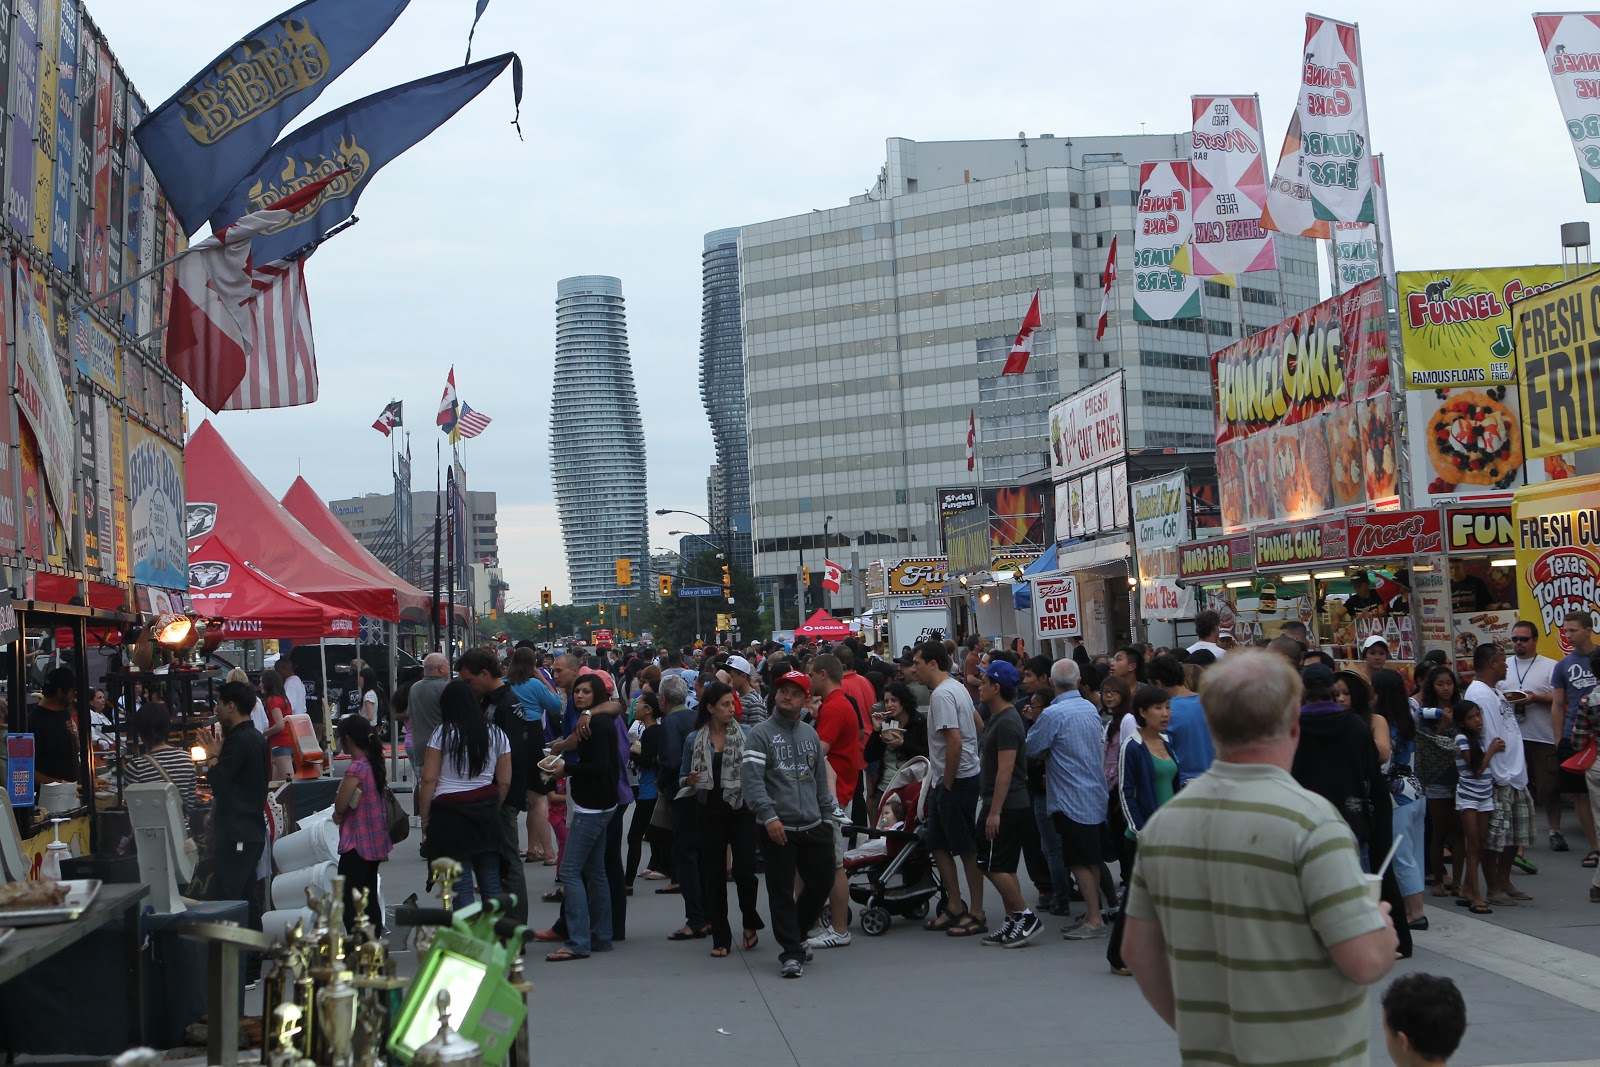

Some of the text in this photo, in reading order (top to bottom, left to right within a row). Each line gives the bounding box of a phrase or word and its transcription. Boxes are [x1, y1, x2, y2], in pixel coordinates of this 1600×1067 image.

[1408, 292, 1504, 328] FUNNEL
[1520, 292, 1586, 359] FRESH
[1282, 326, 1344, 402] CAKE
[1490, 363, 1508, 372] DEEP
[1491, 371, 1510, 380] FRIED
[1412, 368, 1485, 384] FAMOUS FLOATS
[1085, 391, 1108, 418] FRESH
[1077, 425, 1093, 461] CUT
[1096, 413, 1121, 453] FRIES
[162, 449, 183, 538] BBQ
[942, 500, 975, 510] Fingers
[945, 492, 973, 503] Sticky
[1140, 523, 1154, 542] Corn
[1163, 518, 1176, 538] Cob
[1350, 517, 1367, 527] FRIED
[1520, 513, 1573, 549] FRESH
[1257, 531, 1294, 564] FUNNEL
[1294, 528, 1321, 560] CAKE
[1354, 515, 1424, 556] Mars
[1413, 531, 1440, 553] Bar
[1182, 547, 1207, 574] JUMBO
[1208, 545, 1230, 571] EARS
[1546, 554, 1587, 577] Texas
[1045, 597, 1068, 613] CUT
[1160, 586, 1178, 608] Tea
[229, 620, 262, 631] WIN!
[1040, 614, 1076, 631] FRIES
